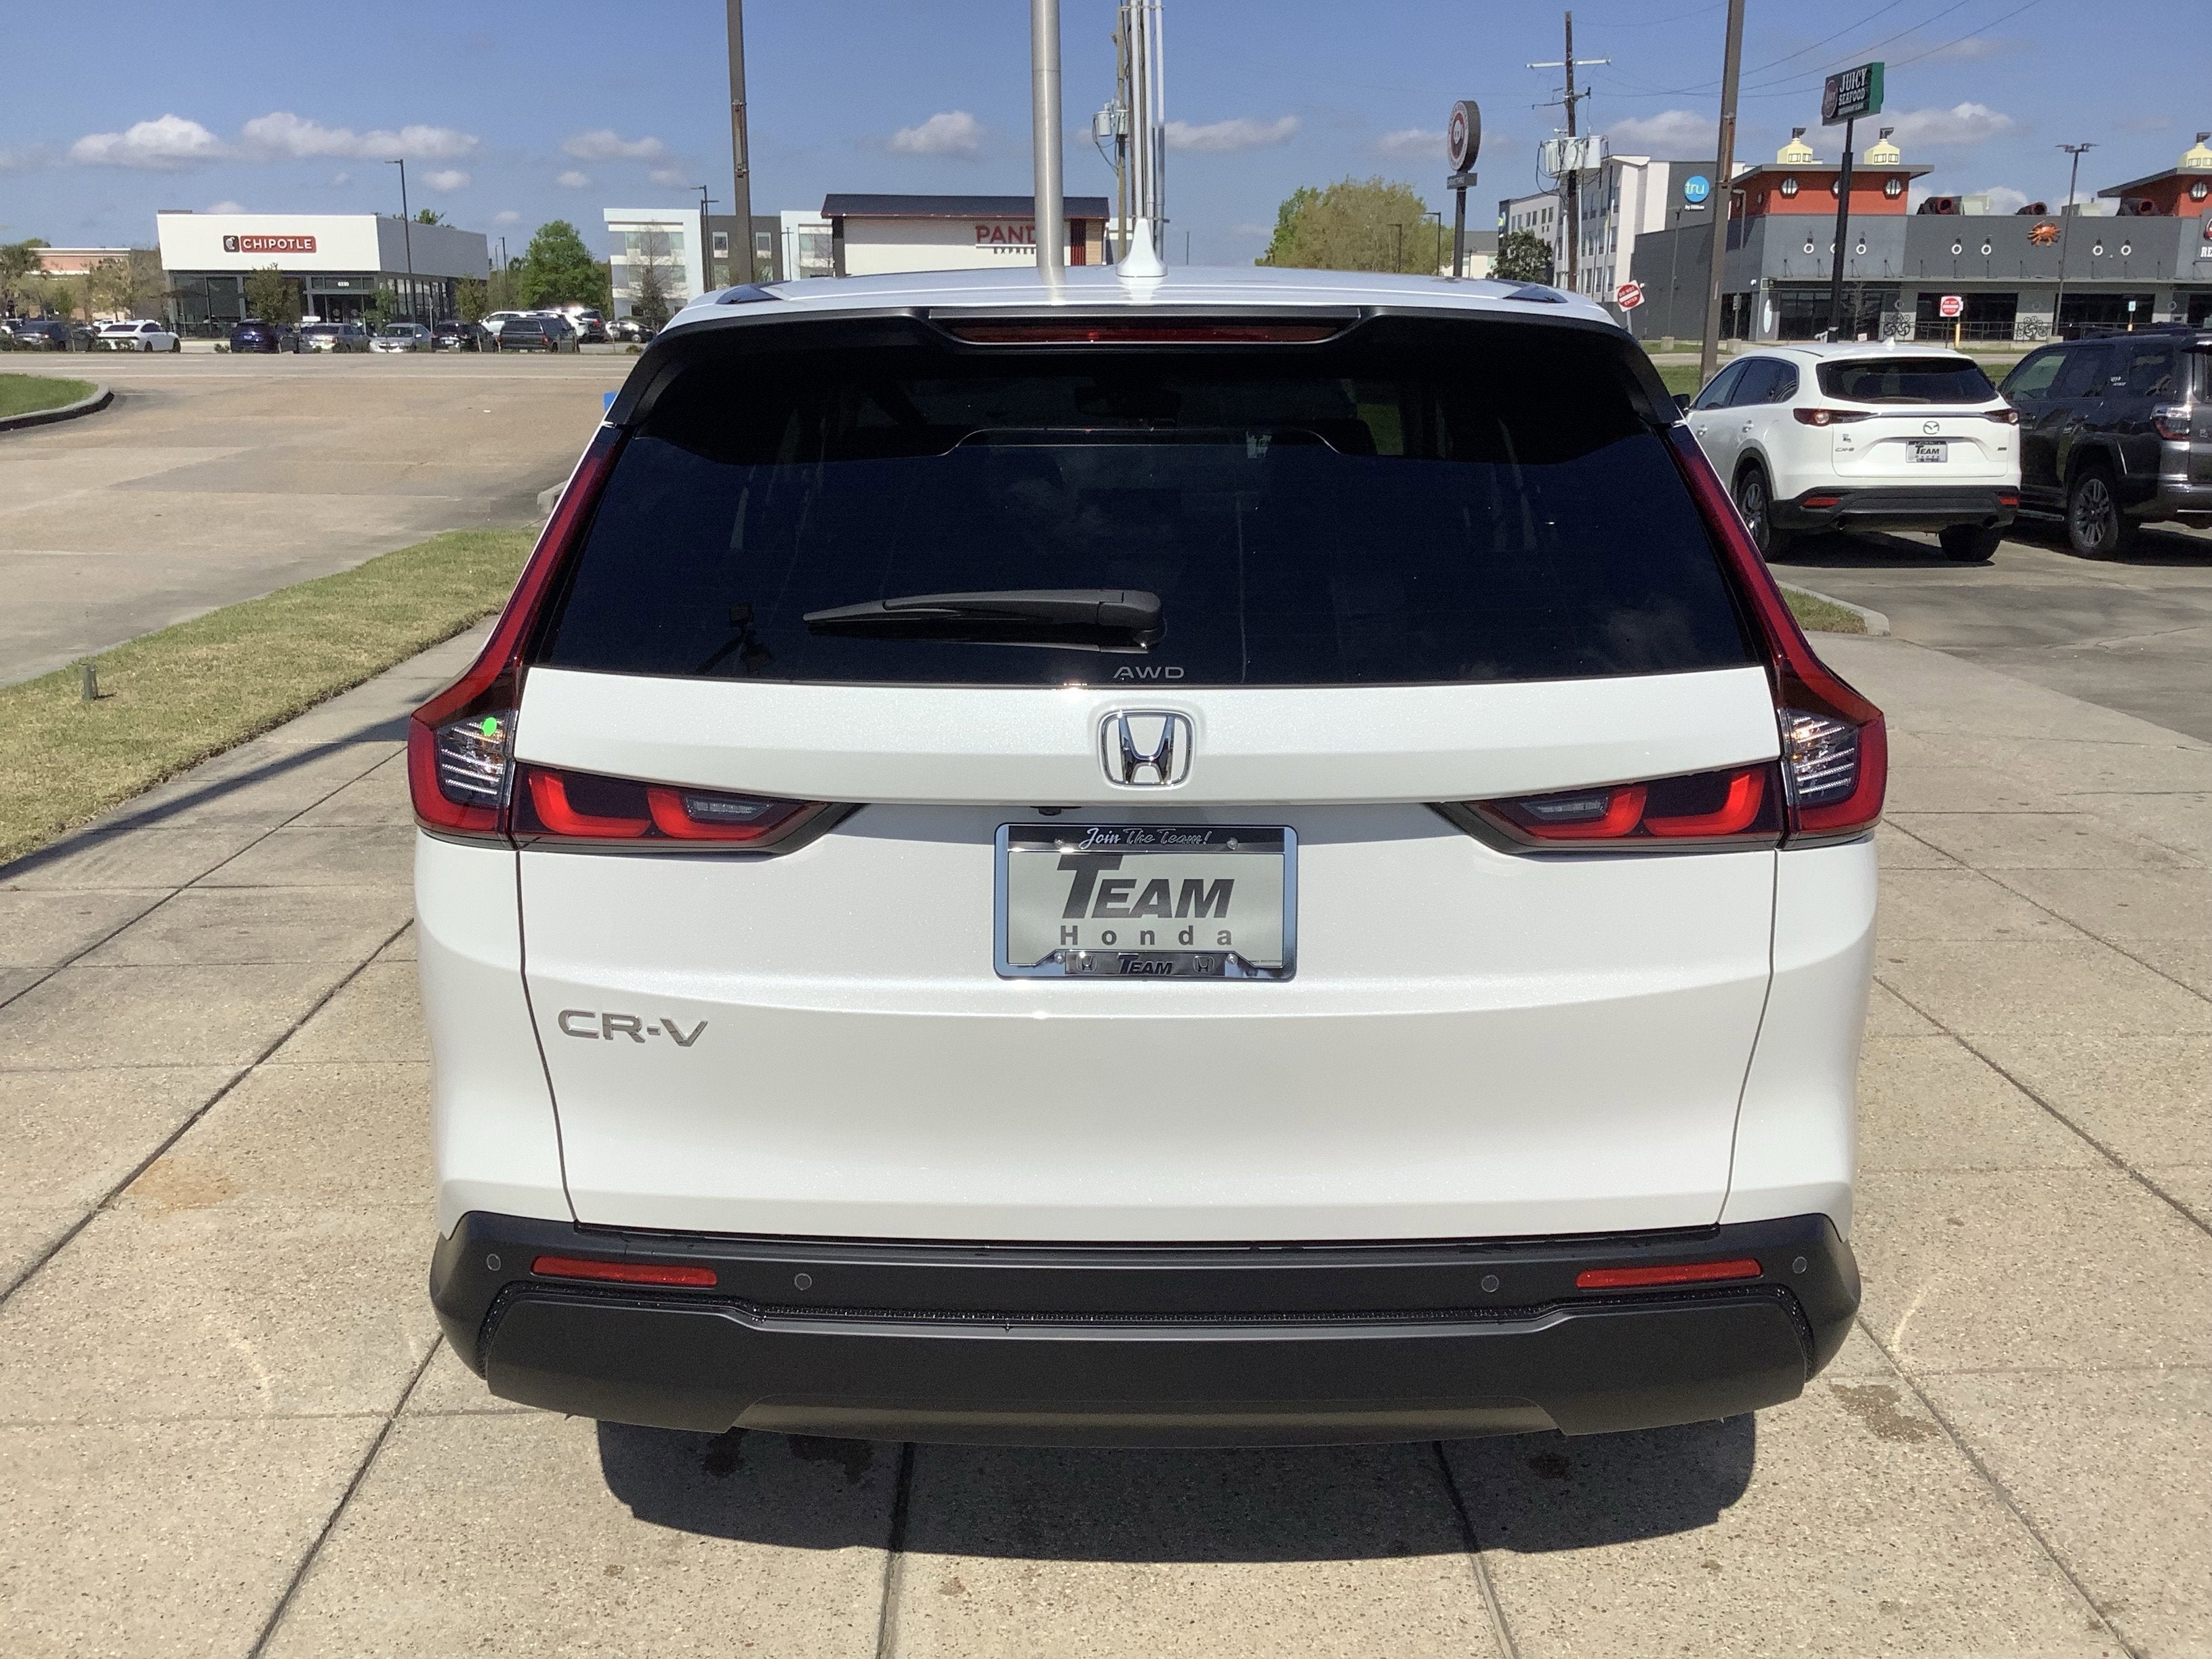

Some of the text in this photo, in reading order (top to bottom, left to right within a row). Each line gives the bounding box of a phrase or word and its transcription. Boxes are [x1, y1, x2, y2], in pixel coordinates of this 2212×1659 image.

[1839, 68, 1868, 92] JUICY
[1839, 87, 1866, 106] SEAFOOD
[1685, 182, 1704, 194] tru
[243, 239, 312, 249] CHIPOTLE
[975, 225, 1036, 244] PAND
[1624, 296, 1637, 305] ENTER
[1915, 445, 1940, 454] TEAM
[1113, 666, 1185, 678] AWD
[1079, 827, 1212, 850] Join The Team!
[1057, 854, 1235, 919] TEAM
[1060, 925, 1233, 946] Honda
[1118, 953, 1173, 975] TEAM
[558, 1008, 708, 1047] CR-V
